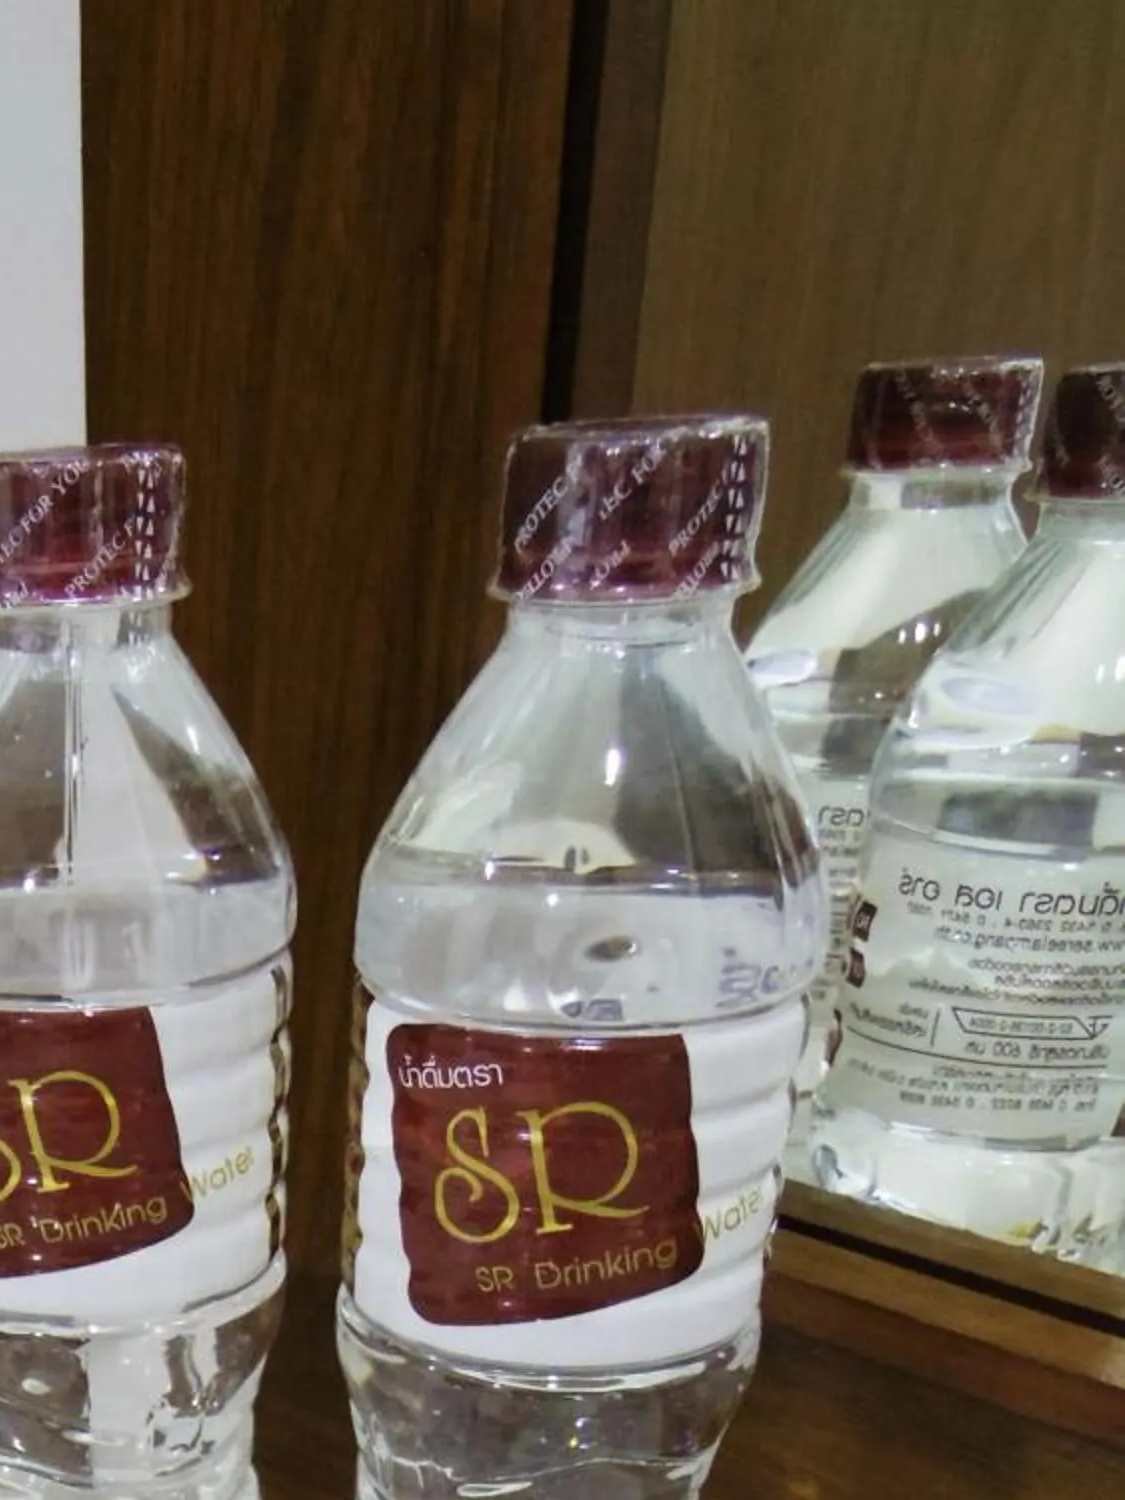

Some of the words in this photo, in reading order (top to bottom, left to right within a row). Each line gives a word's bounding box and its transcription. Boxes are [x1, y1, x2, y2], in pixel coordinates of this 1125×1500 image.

[21, 492, 56, 534] FOR
[397, 1054, 505, 1090] น้ำดื่มตรา
[433, 1101, 651, 1245] SR
[38, 1195, 169, 1246] Drinking
[475, 1266, 515, 1293] SR
[534, 1240, 677, 1291] Drinking
